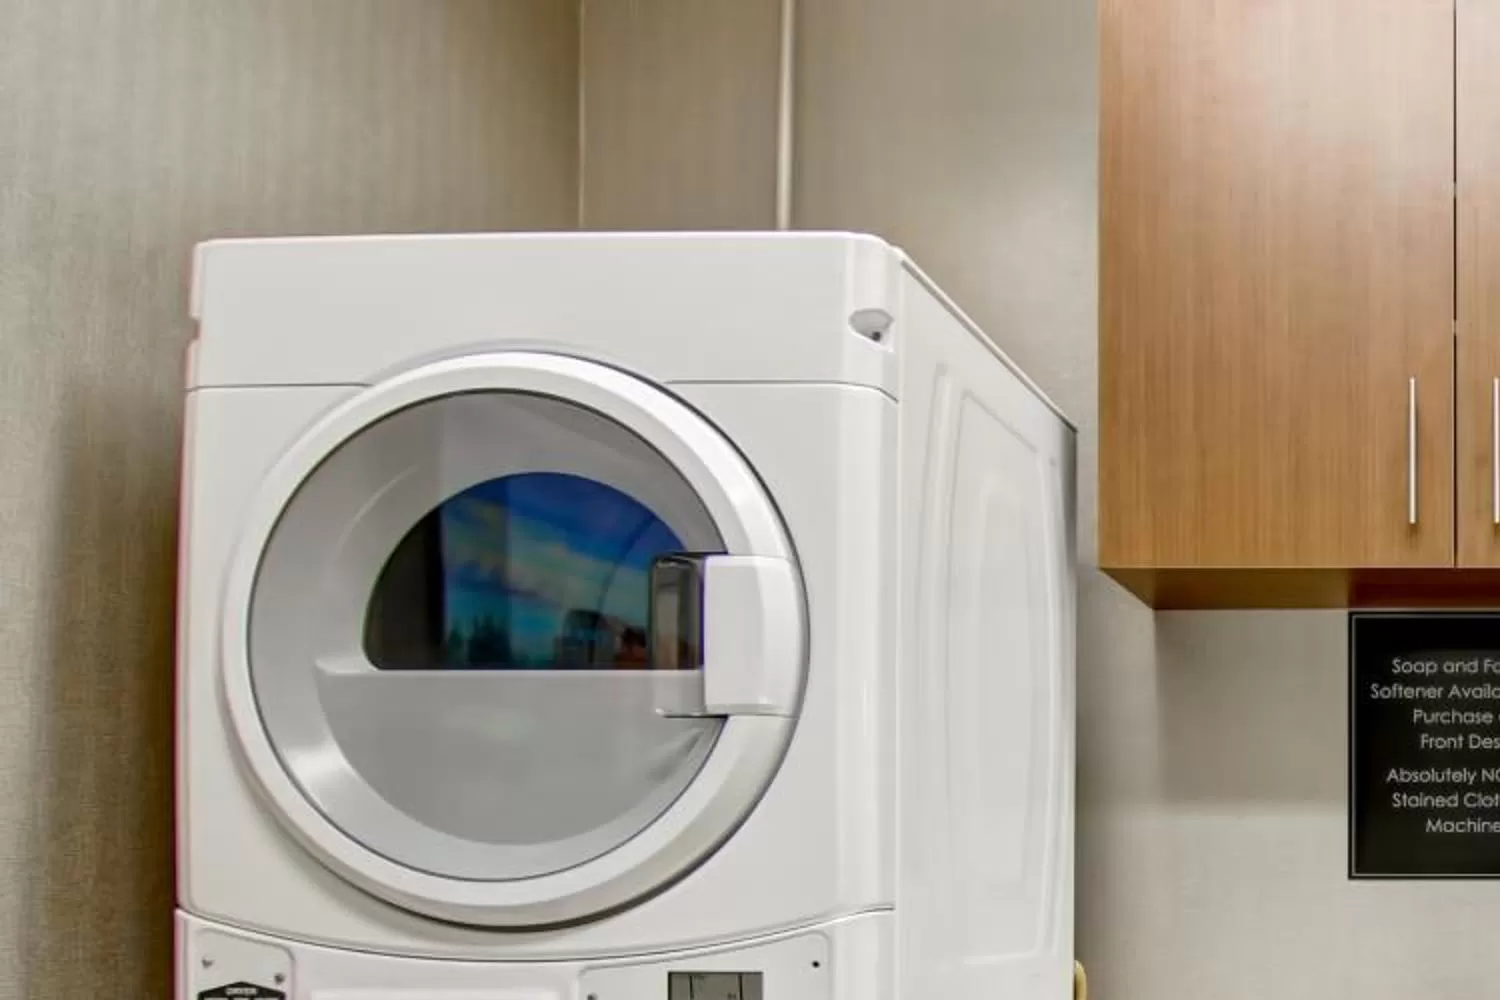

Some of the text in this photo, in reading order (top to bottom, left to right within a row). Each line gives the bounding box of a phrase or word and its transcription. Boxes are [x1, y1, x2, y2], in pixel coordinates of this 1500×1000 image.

[1391, 658, 1438, 677] Soap
[1443, 658, 1479, 675] and
[1370, 683, 1444, 700] Softener
[1413, 708, 1494, 725] Purchase
[1420, 733, 1465, 750] Front
[1386, 767, 1477, 785] Absolutely
[1392, 791, 1459, 808] Stained
